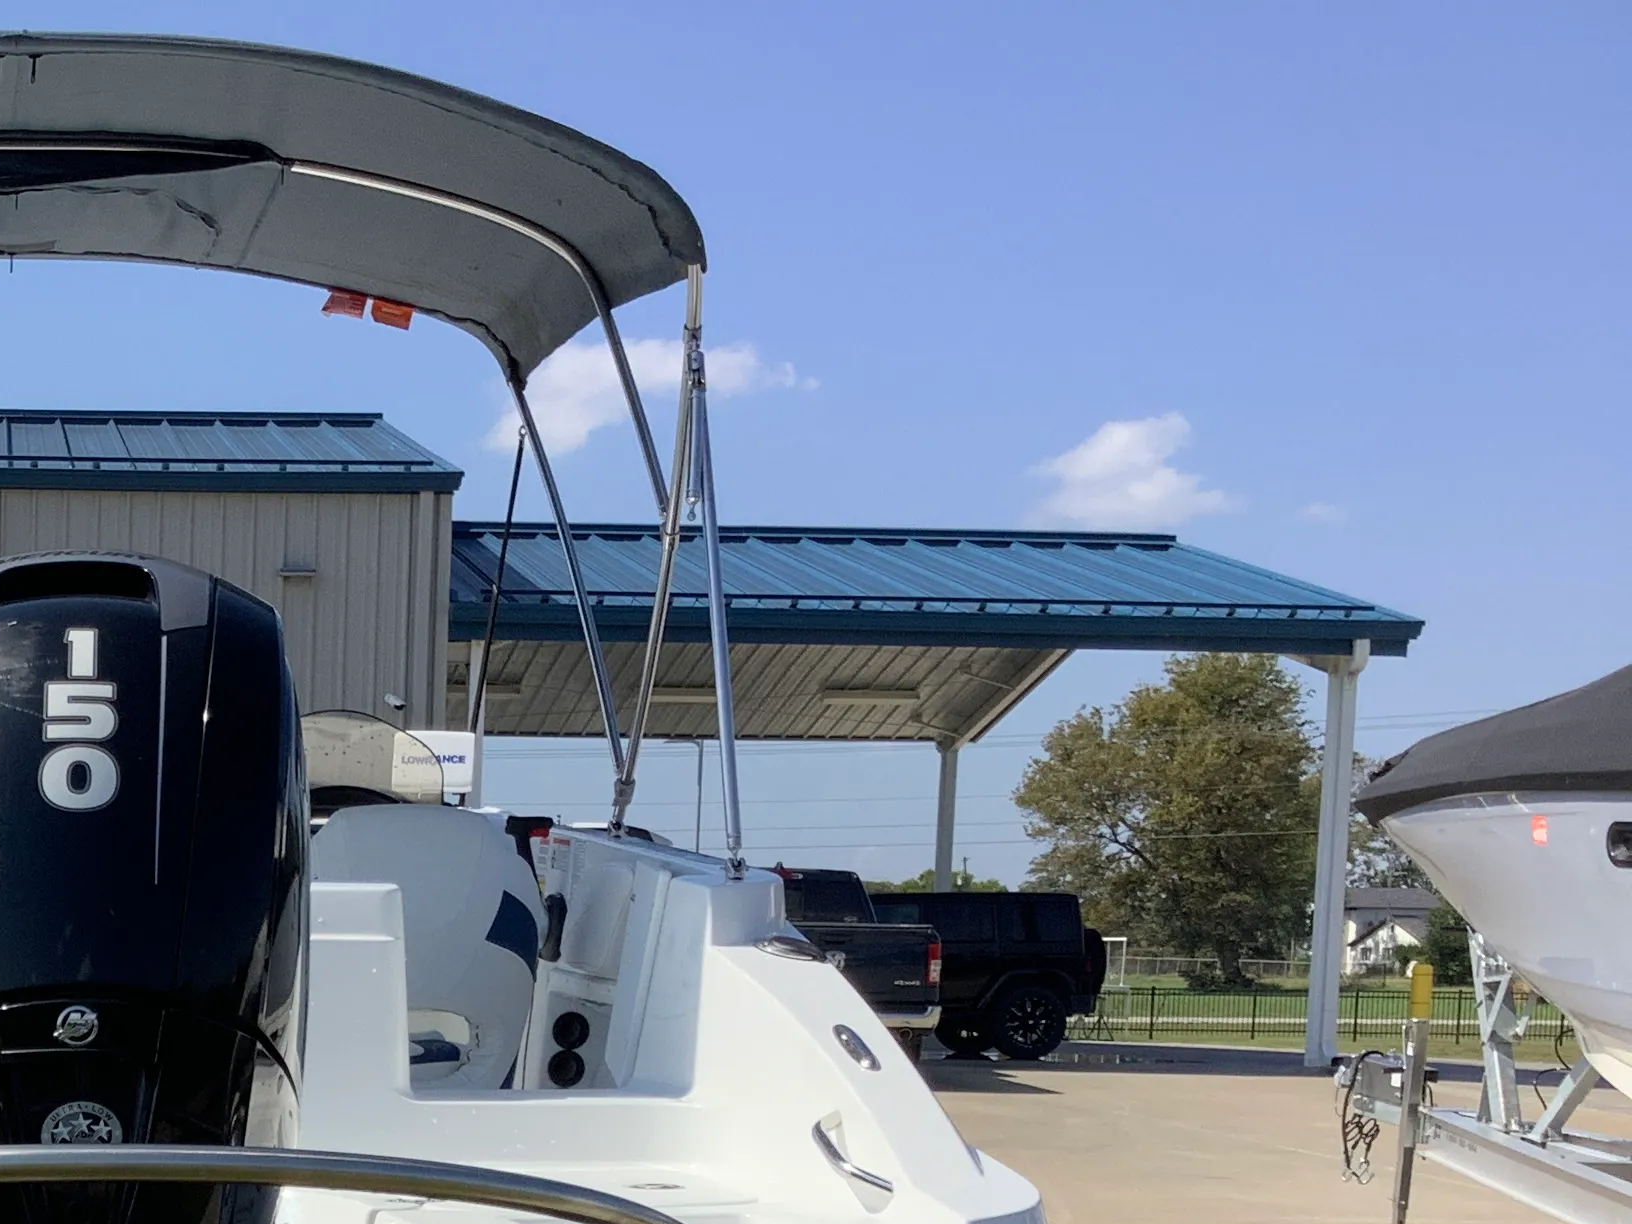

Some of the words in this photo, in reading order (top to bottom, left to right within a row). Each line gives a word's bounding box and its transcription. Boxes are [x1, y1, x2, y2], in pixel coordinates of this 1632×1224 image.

[38, 628, 120, 812] 150
[49, 1103, 83, 1122] ULTRA
[91, 1104, 114, 1121] LOW
